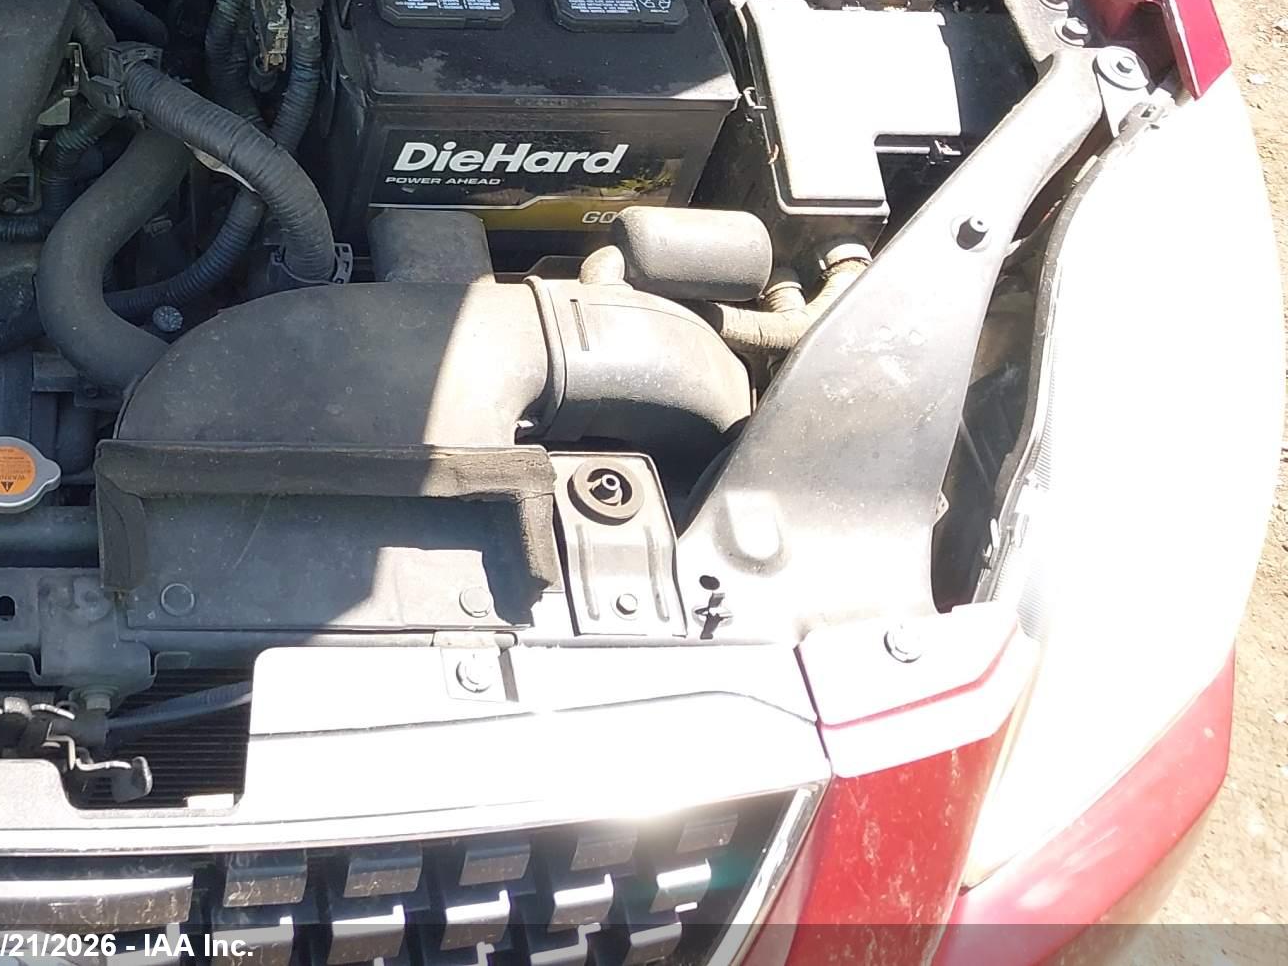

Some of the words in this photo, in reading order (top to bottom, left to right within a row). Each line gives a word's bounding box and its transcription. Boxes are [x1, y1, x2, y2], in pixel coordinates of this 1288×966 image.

[393, 141, 630, 174] DieHard
[385, 176, 441, 185] POWER
[445, 177, 501, 185] AHEAD
